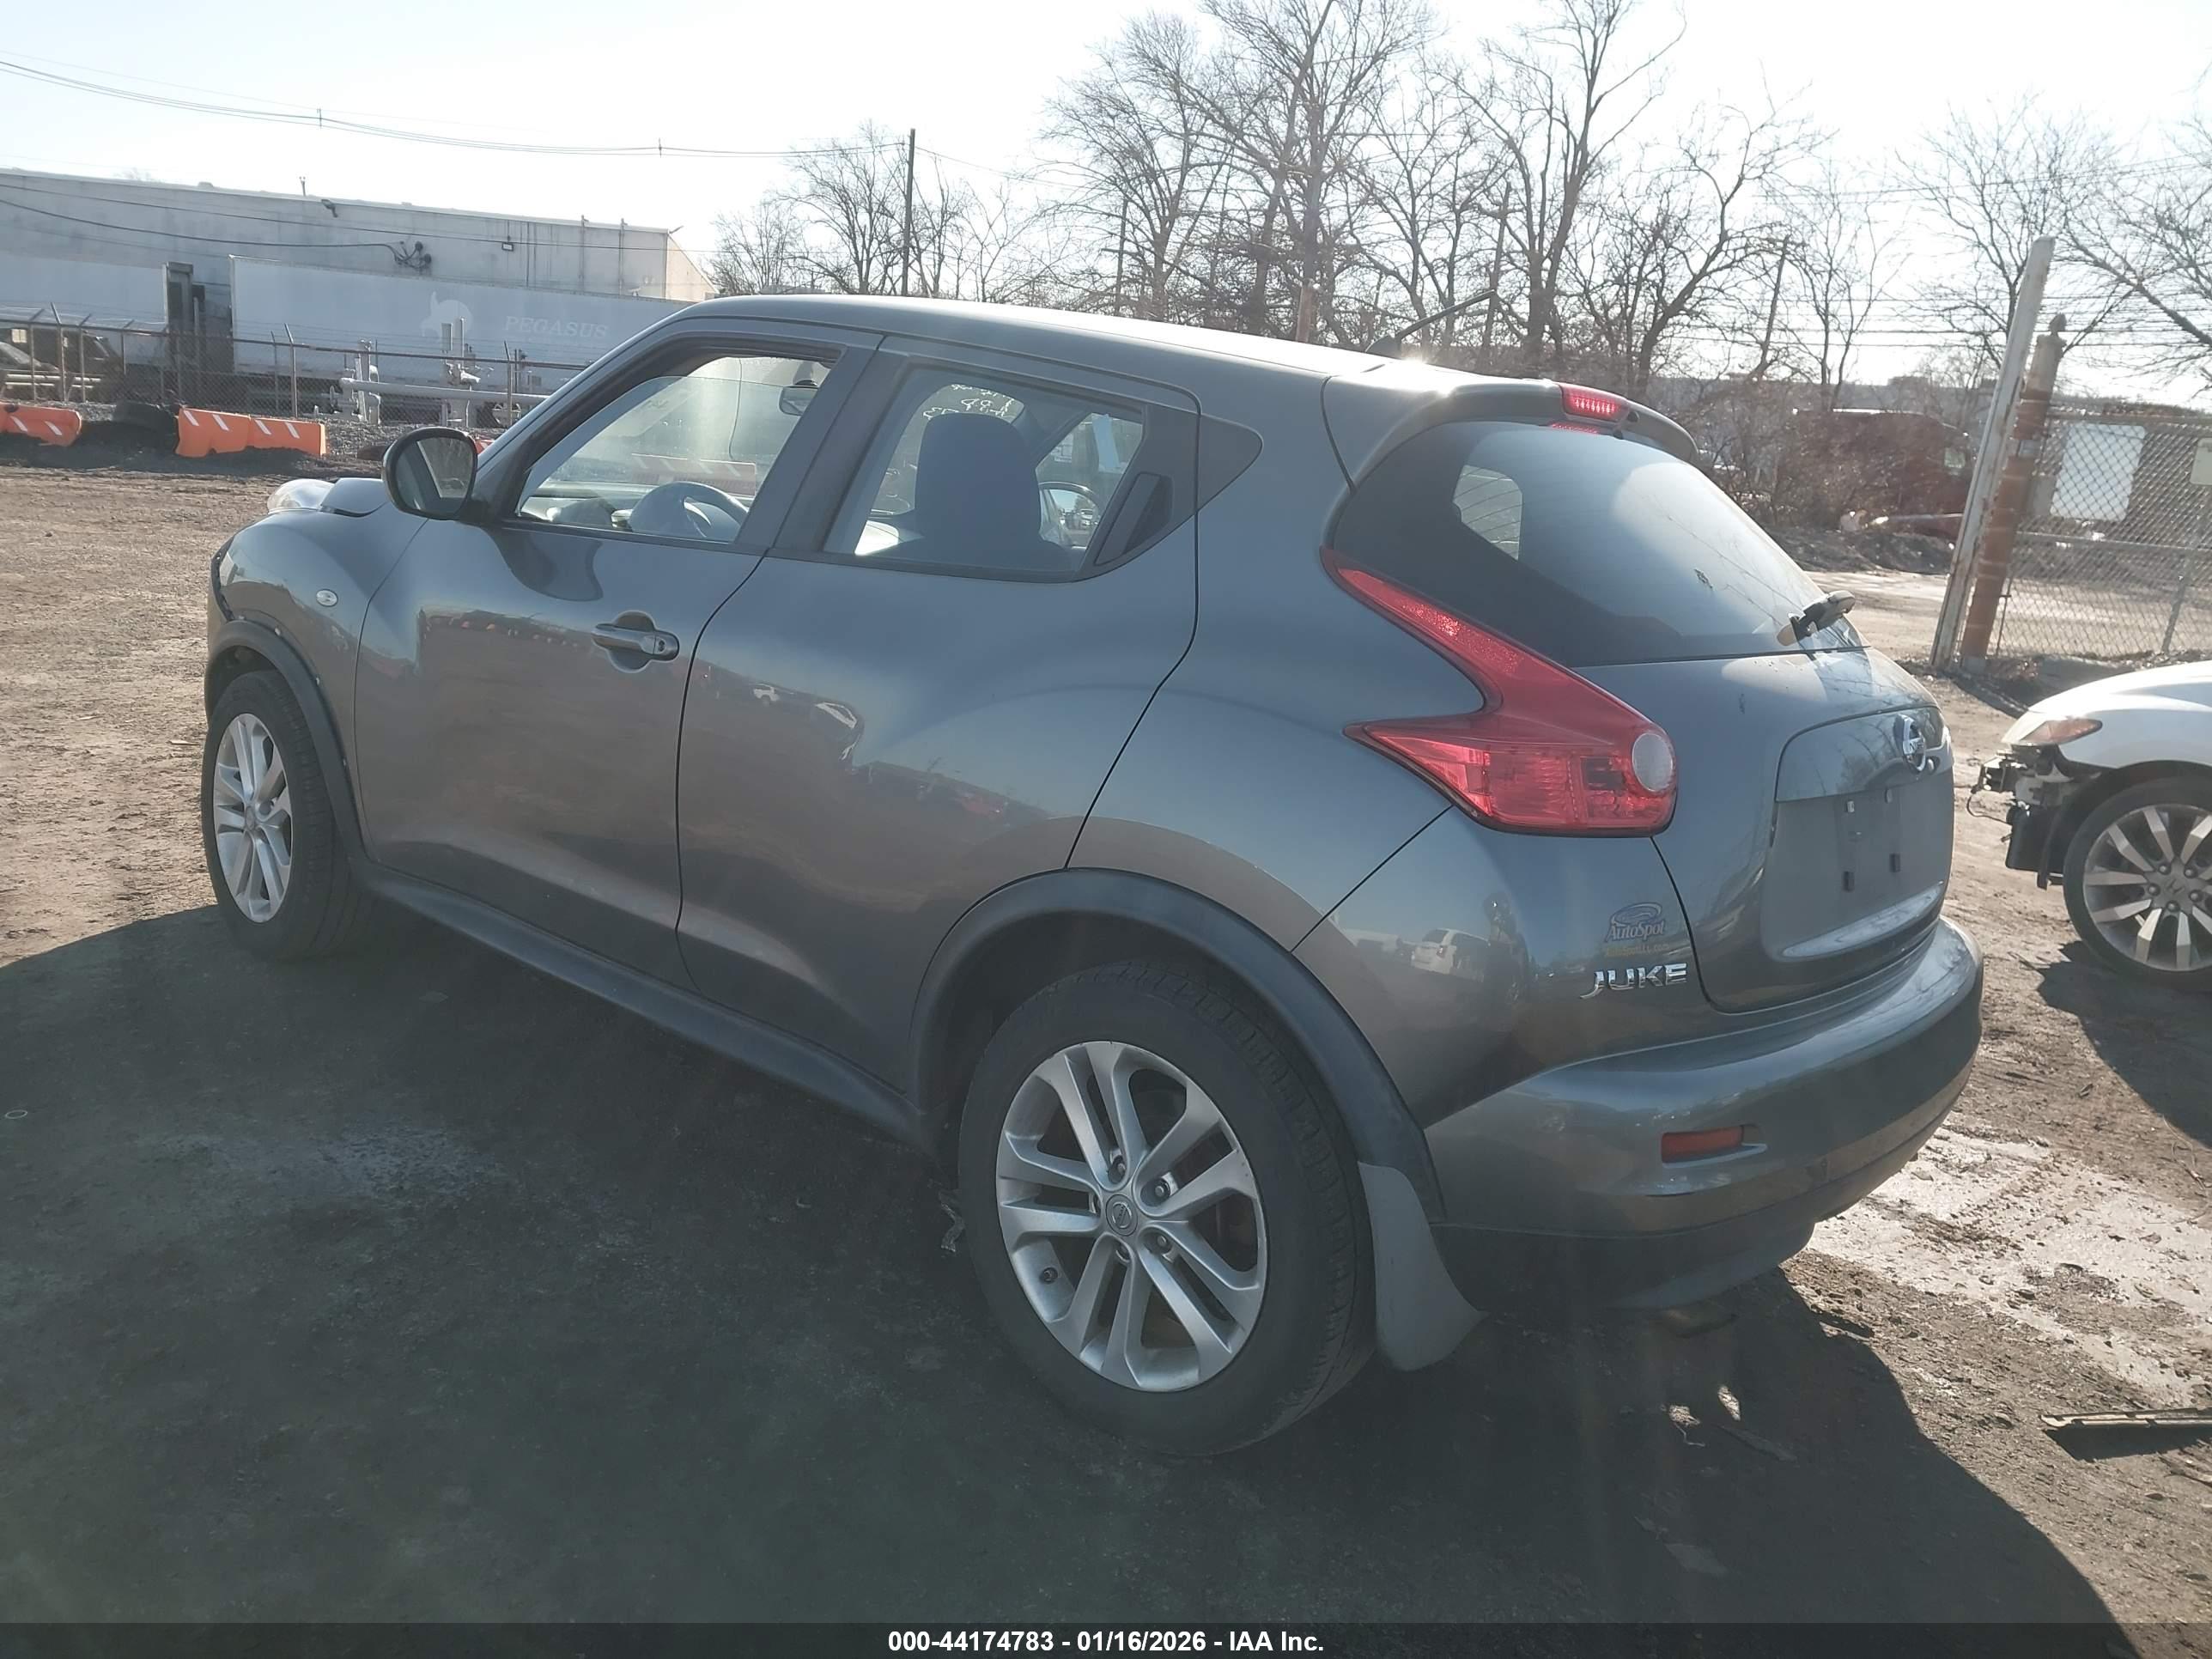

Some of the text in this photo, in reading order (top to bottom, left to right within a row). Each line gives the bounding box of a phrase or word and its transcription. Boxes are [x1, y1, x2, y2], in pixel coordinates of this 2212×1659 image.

[503, 315, 609, 338] PEGASUS
[1605, 921, 1664, 942] AutoSpot
[1580, 963, 1687, 999] JUKE
